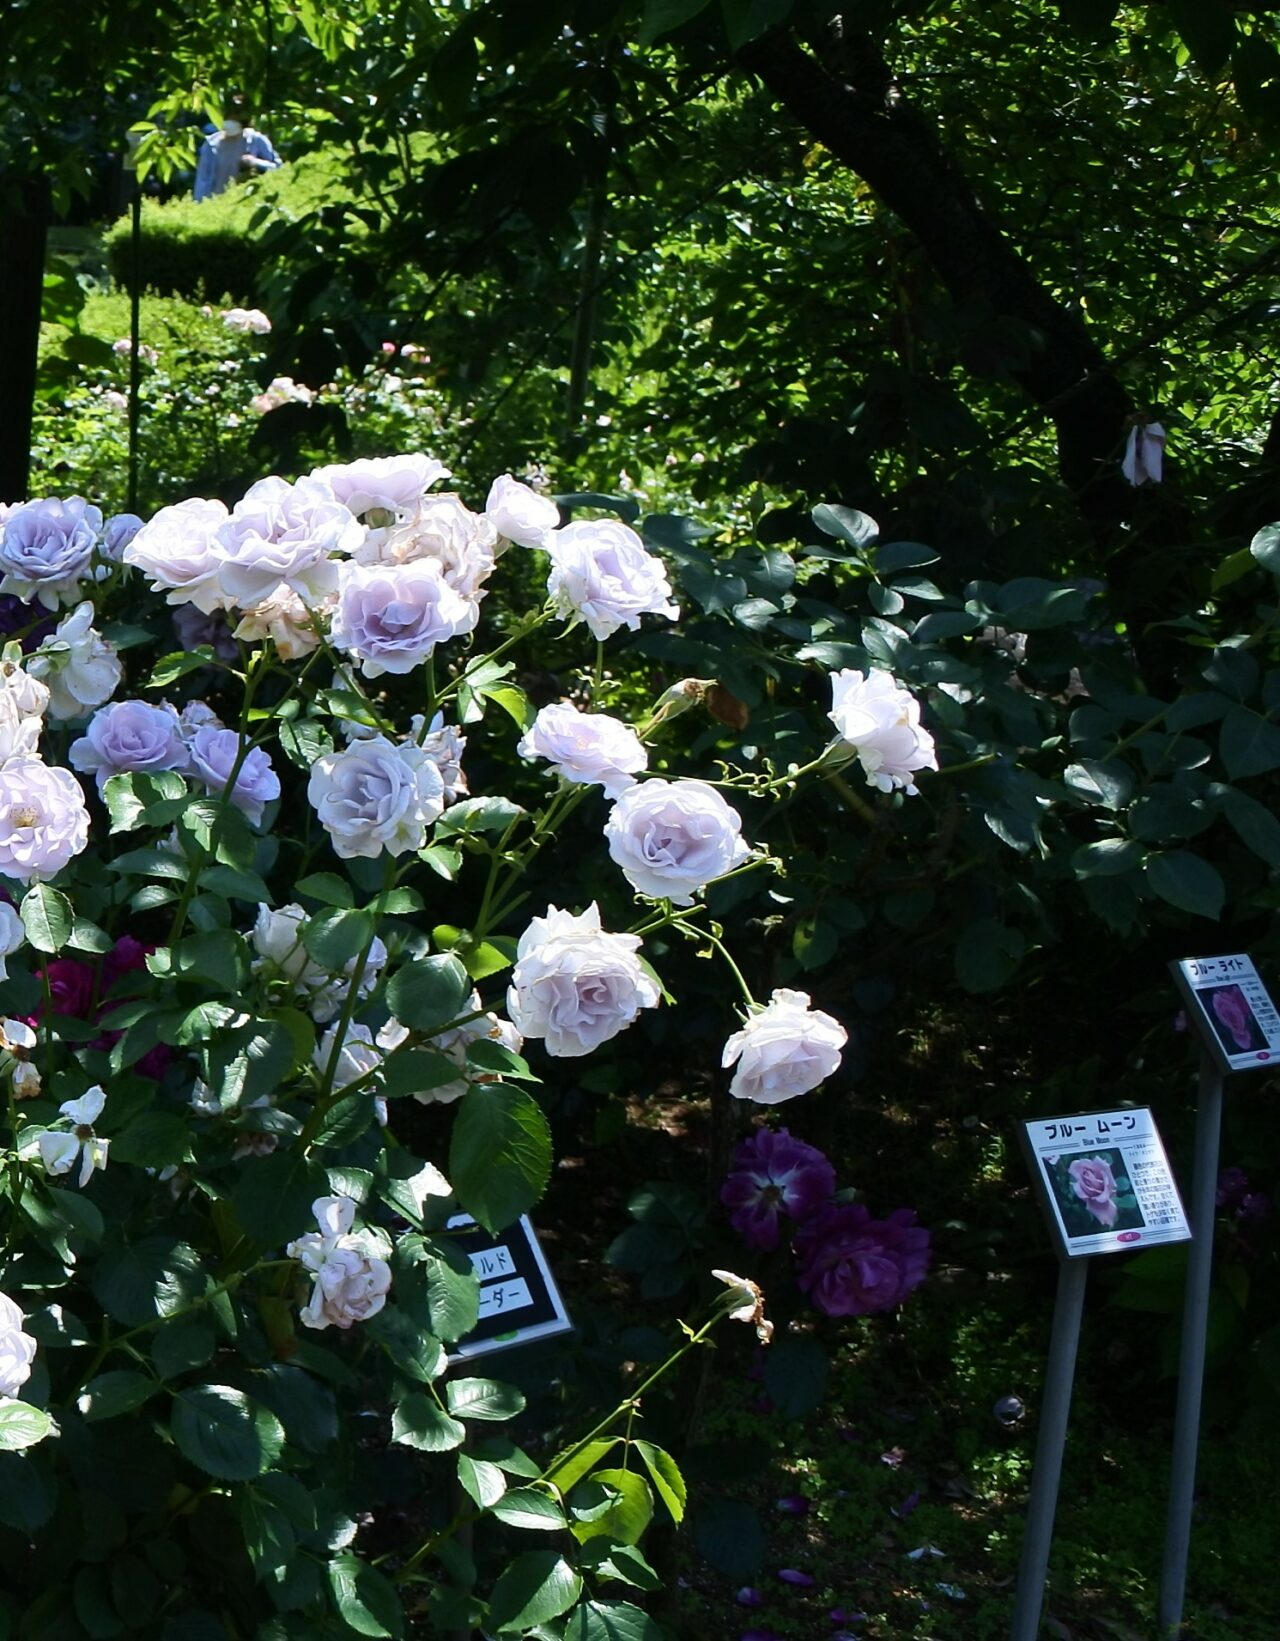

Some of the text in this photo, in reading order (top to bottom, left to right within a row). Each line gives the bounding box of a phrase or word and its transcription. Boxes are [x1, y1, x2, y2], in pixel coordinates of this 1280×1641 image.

[1190, 959, 1243, 975] ブルー ライト
[1044, 1116, 1136, 1139] ブルー ムーン
[480, 1252, 506, 1274] ルド
